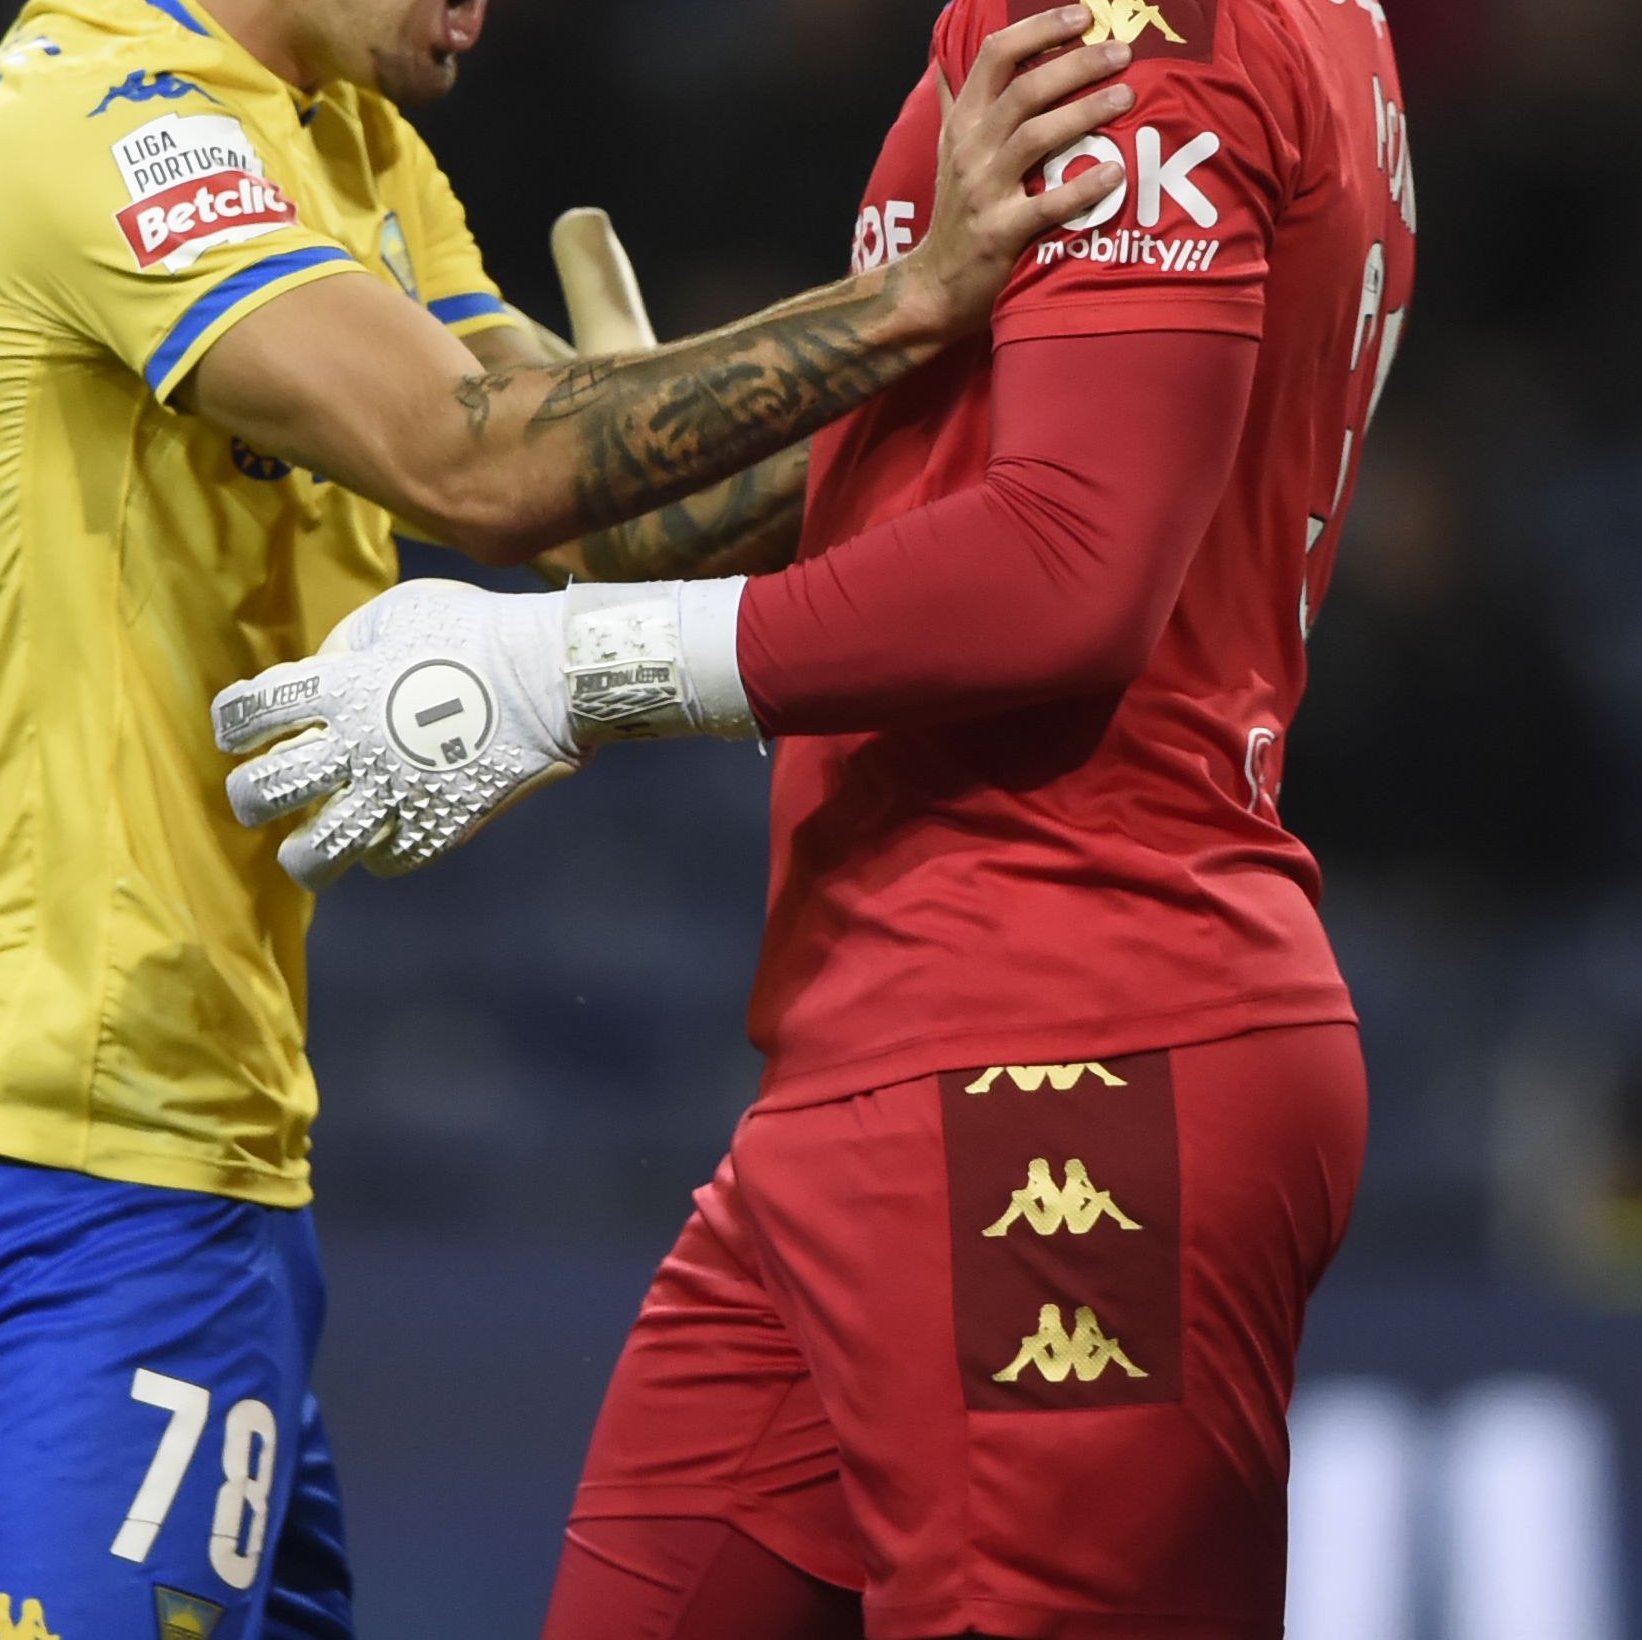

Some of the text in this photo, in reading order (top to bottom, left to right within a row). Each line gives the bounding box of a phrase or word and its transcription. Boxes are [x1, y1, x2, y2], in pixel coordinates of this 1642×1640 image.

[122, 130, 178, 166] LIGA
[133, 146, 253, 193] PORTUGAL
[1043, 126, 1220, 231] OK
[137, 180, 288, 253] Betclic
[1035, 228, 1182, 272] mobility
[110, 1367, 277, 1590] 78
